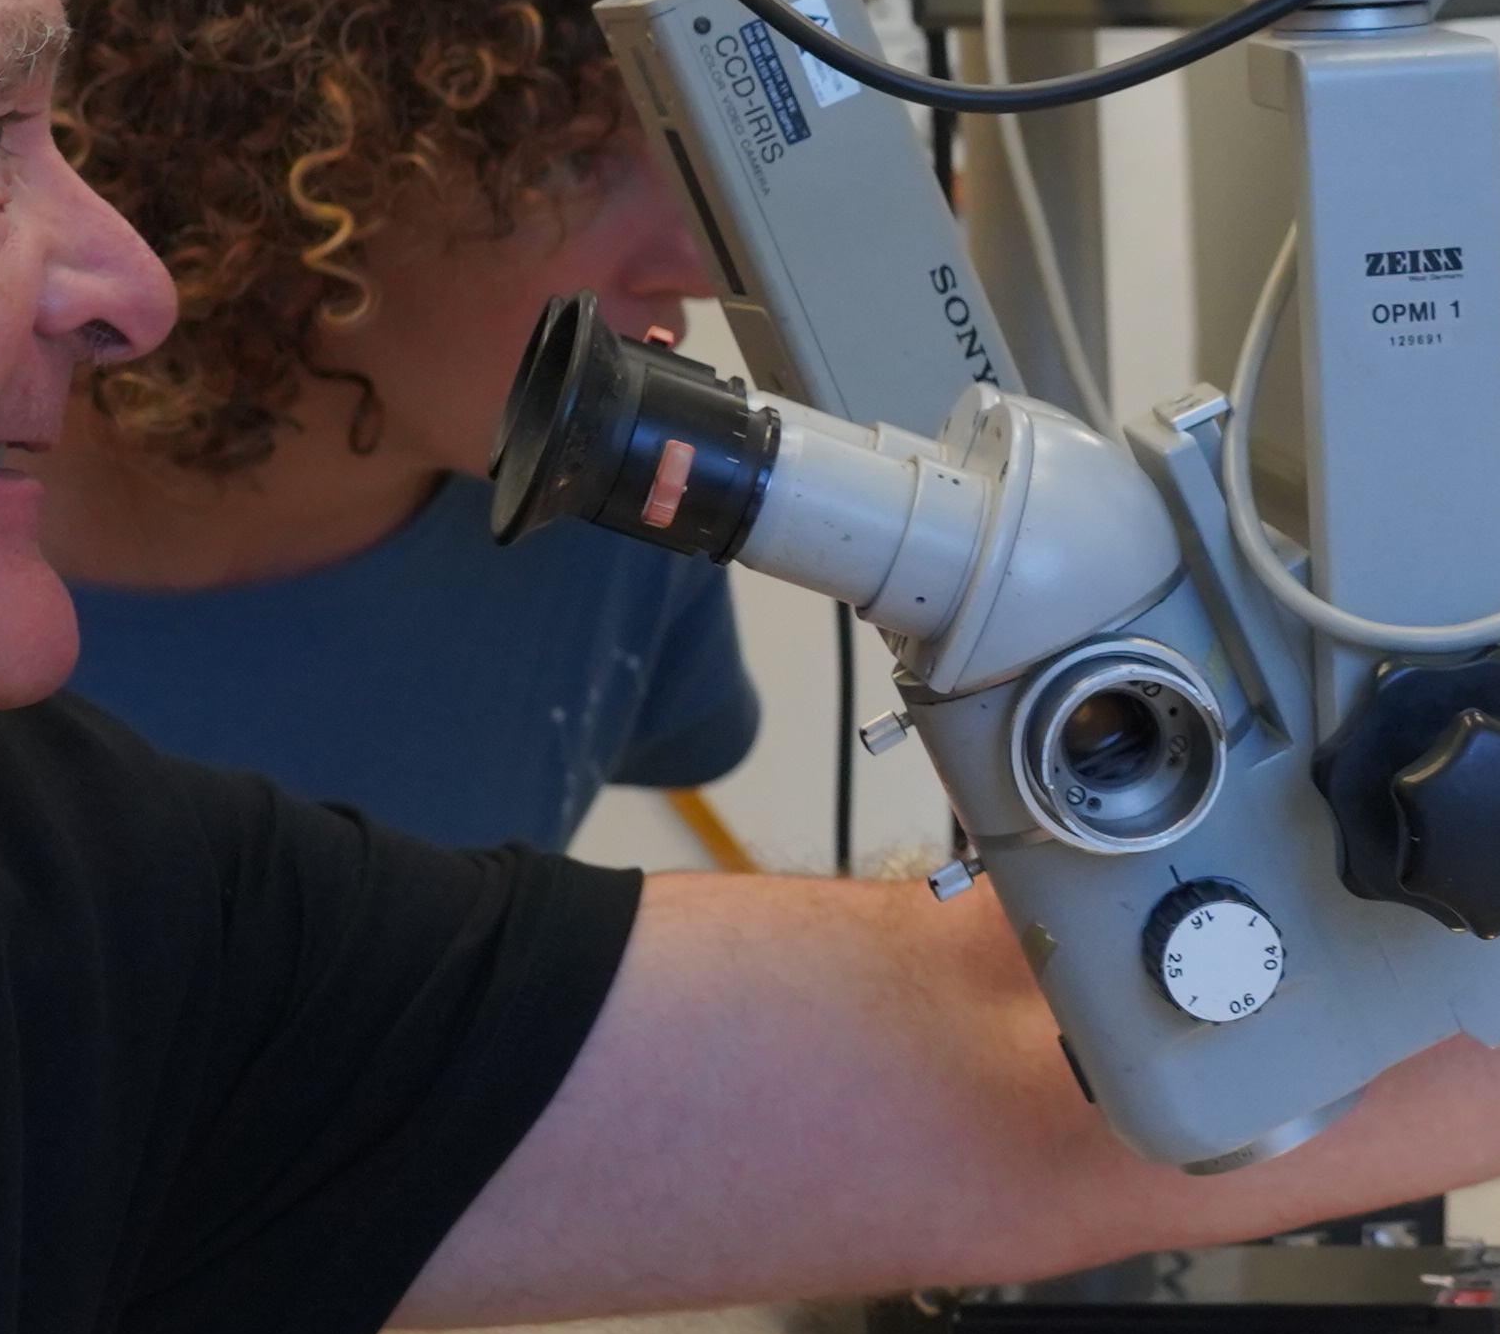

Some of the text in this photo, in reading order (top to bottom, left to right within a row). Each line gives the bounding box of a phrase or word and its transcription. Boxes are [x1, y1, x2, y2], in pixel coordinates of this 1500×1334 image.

[700, 44, 771, 197] COLOR VIDEO CAMERA
[715, 35, 785, 165] CCD-IRIS
[1365, 247, 1463, 277] ZEISS
[1372, 299, 1460, 324] OPMI 1
[929, 264, 1000, 388] SONY
